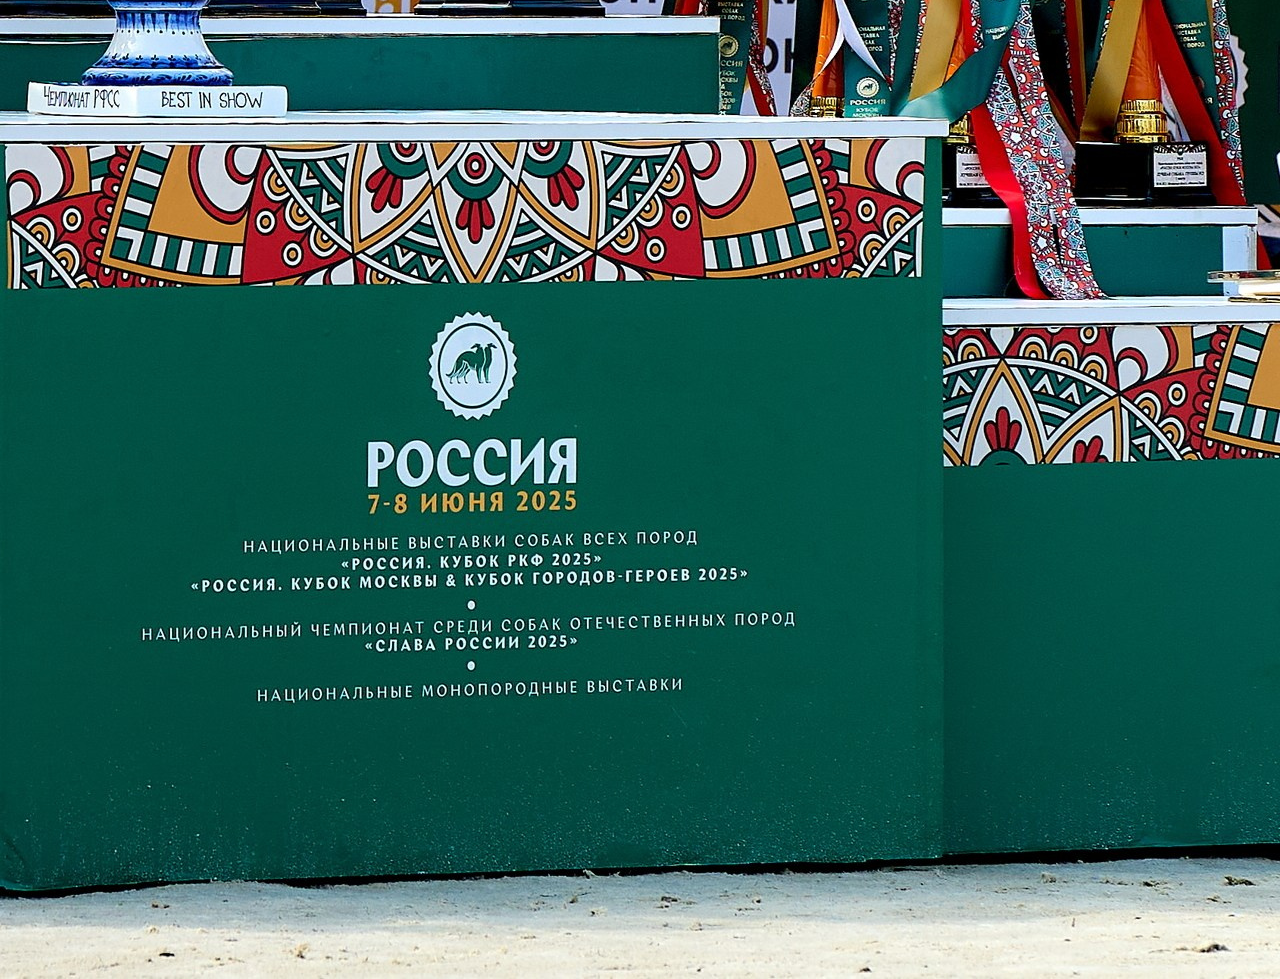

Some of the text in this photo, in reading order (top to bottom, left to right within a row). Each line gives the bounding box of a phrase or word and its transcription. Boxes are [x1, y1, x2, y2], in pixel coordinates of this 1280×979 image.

[162, 91, 263, 108] BEST IN SHOW
[368, 437, 577, 487] РОССИЯ
[368, 490, 577, 514] 7-8 ИЮНЯ 2025
[244, 531, 698, 554] НАЦИОНАЛЬНЫЕ ВЫСТАВКИ СОБАК ВСЕХ ПОРОД
[342, 553, 601, 571] «РОССИЯ. КУБОК РКФ 2025»
[191, 567, 748, 592] «РОССИЯ. КУБОК МОСКВЫ & КУБОК ГОРОДОВ-ГЕРОЕВ 2025»
[142, 612, 795, 642] НАЦИОНАЛЬНЫЙ ЧЕМПИОНАТ СРЕДИ СОБАК ОТЕЧЕСТВЕННЫХ ПОРОД
[365, 635, 577, 652] «СЛАВА РОССИИ 2025»
[257, 679, 682, 703] НАЦИОНАЛЬНЫЕ МОНОПОРОДНЫЕ ВЫСТАВКИ
